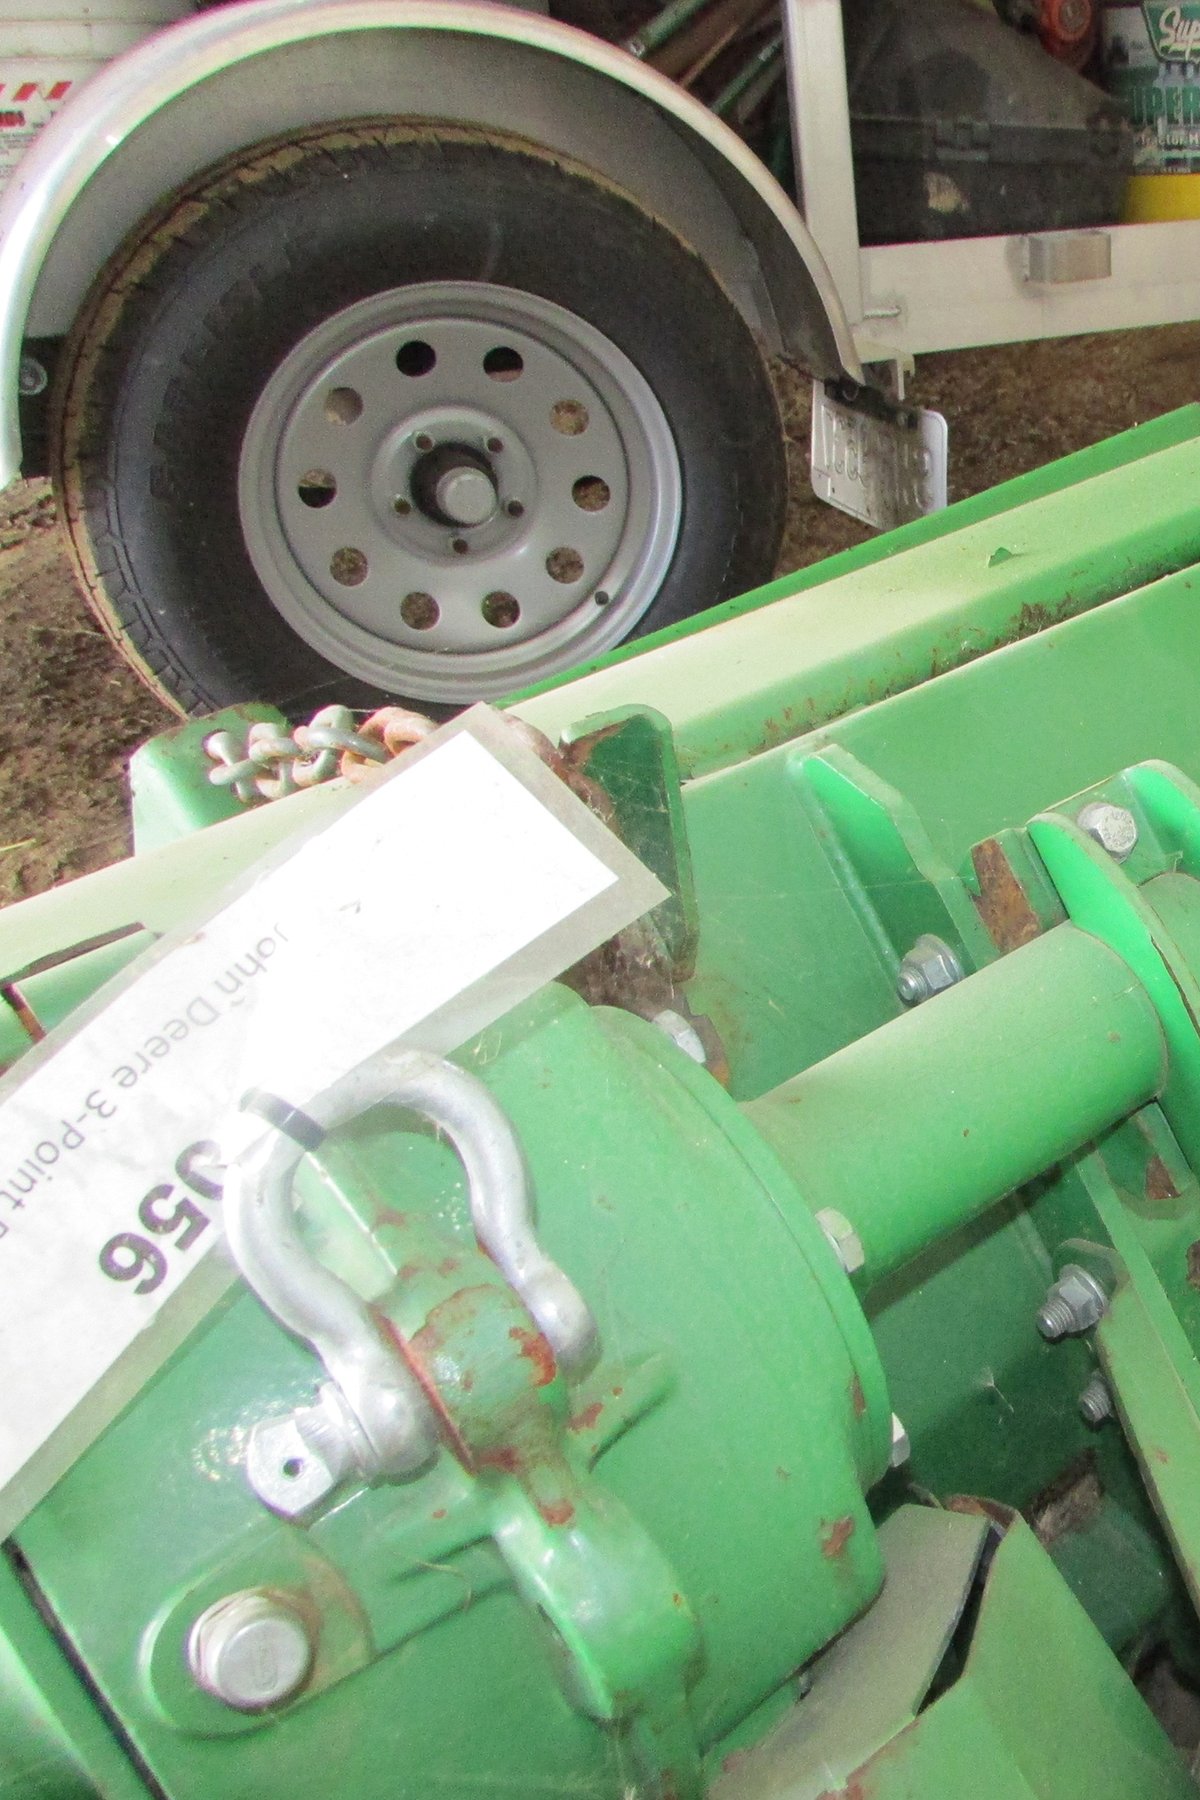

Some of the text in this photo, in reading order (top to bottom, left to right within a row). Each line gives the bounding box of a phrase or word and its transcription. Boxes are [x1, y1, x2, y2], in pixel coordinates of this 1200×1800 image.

[0, 921, 290, 1212] John Deere 3-Point
